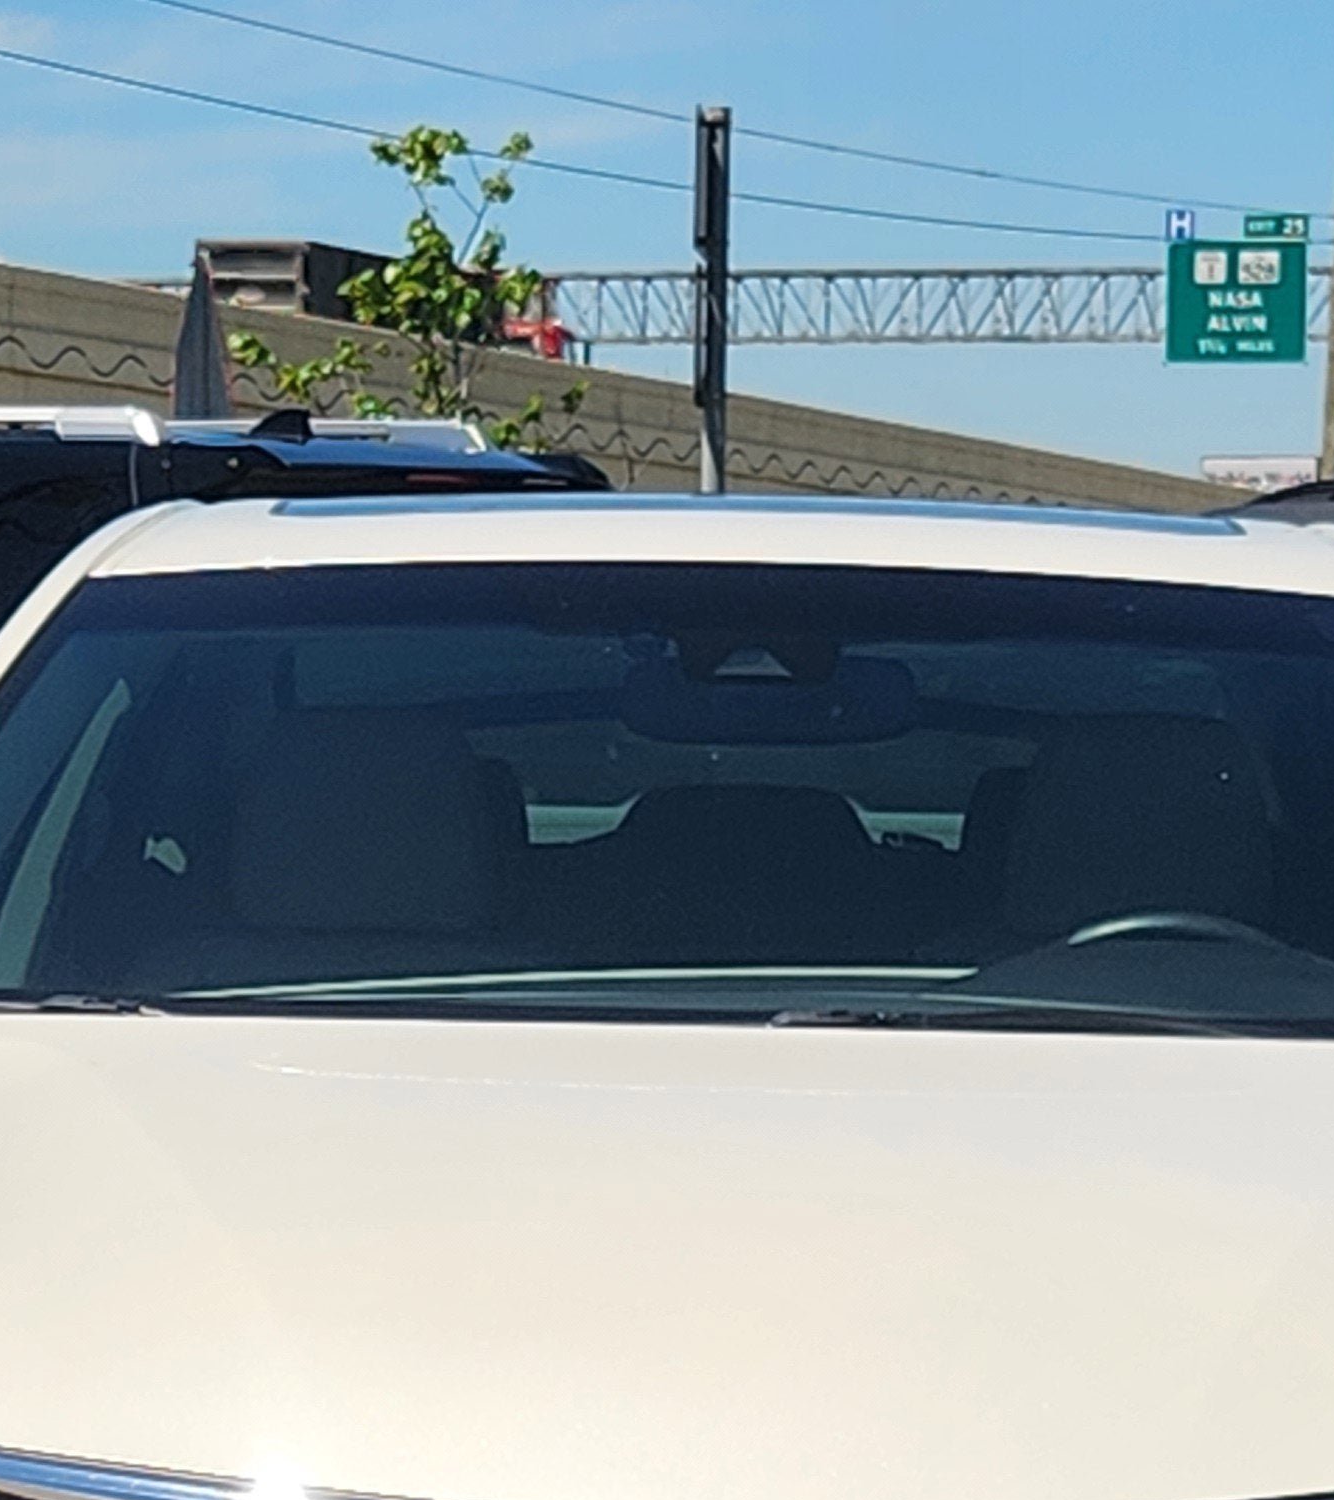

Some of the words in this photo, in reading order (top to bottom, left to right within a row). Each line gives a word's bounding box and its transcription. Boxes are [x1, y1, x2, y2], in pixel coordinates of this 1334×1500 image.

[1170, 210, 1192, 239] H
[1208, 290, 1264, 309] NASA
[1207, 313, 1268, 332] ALVIN
